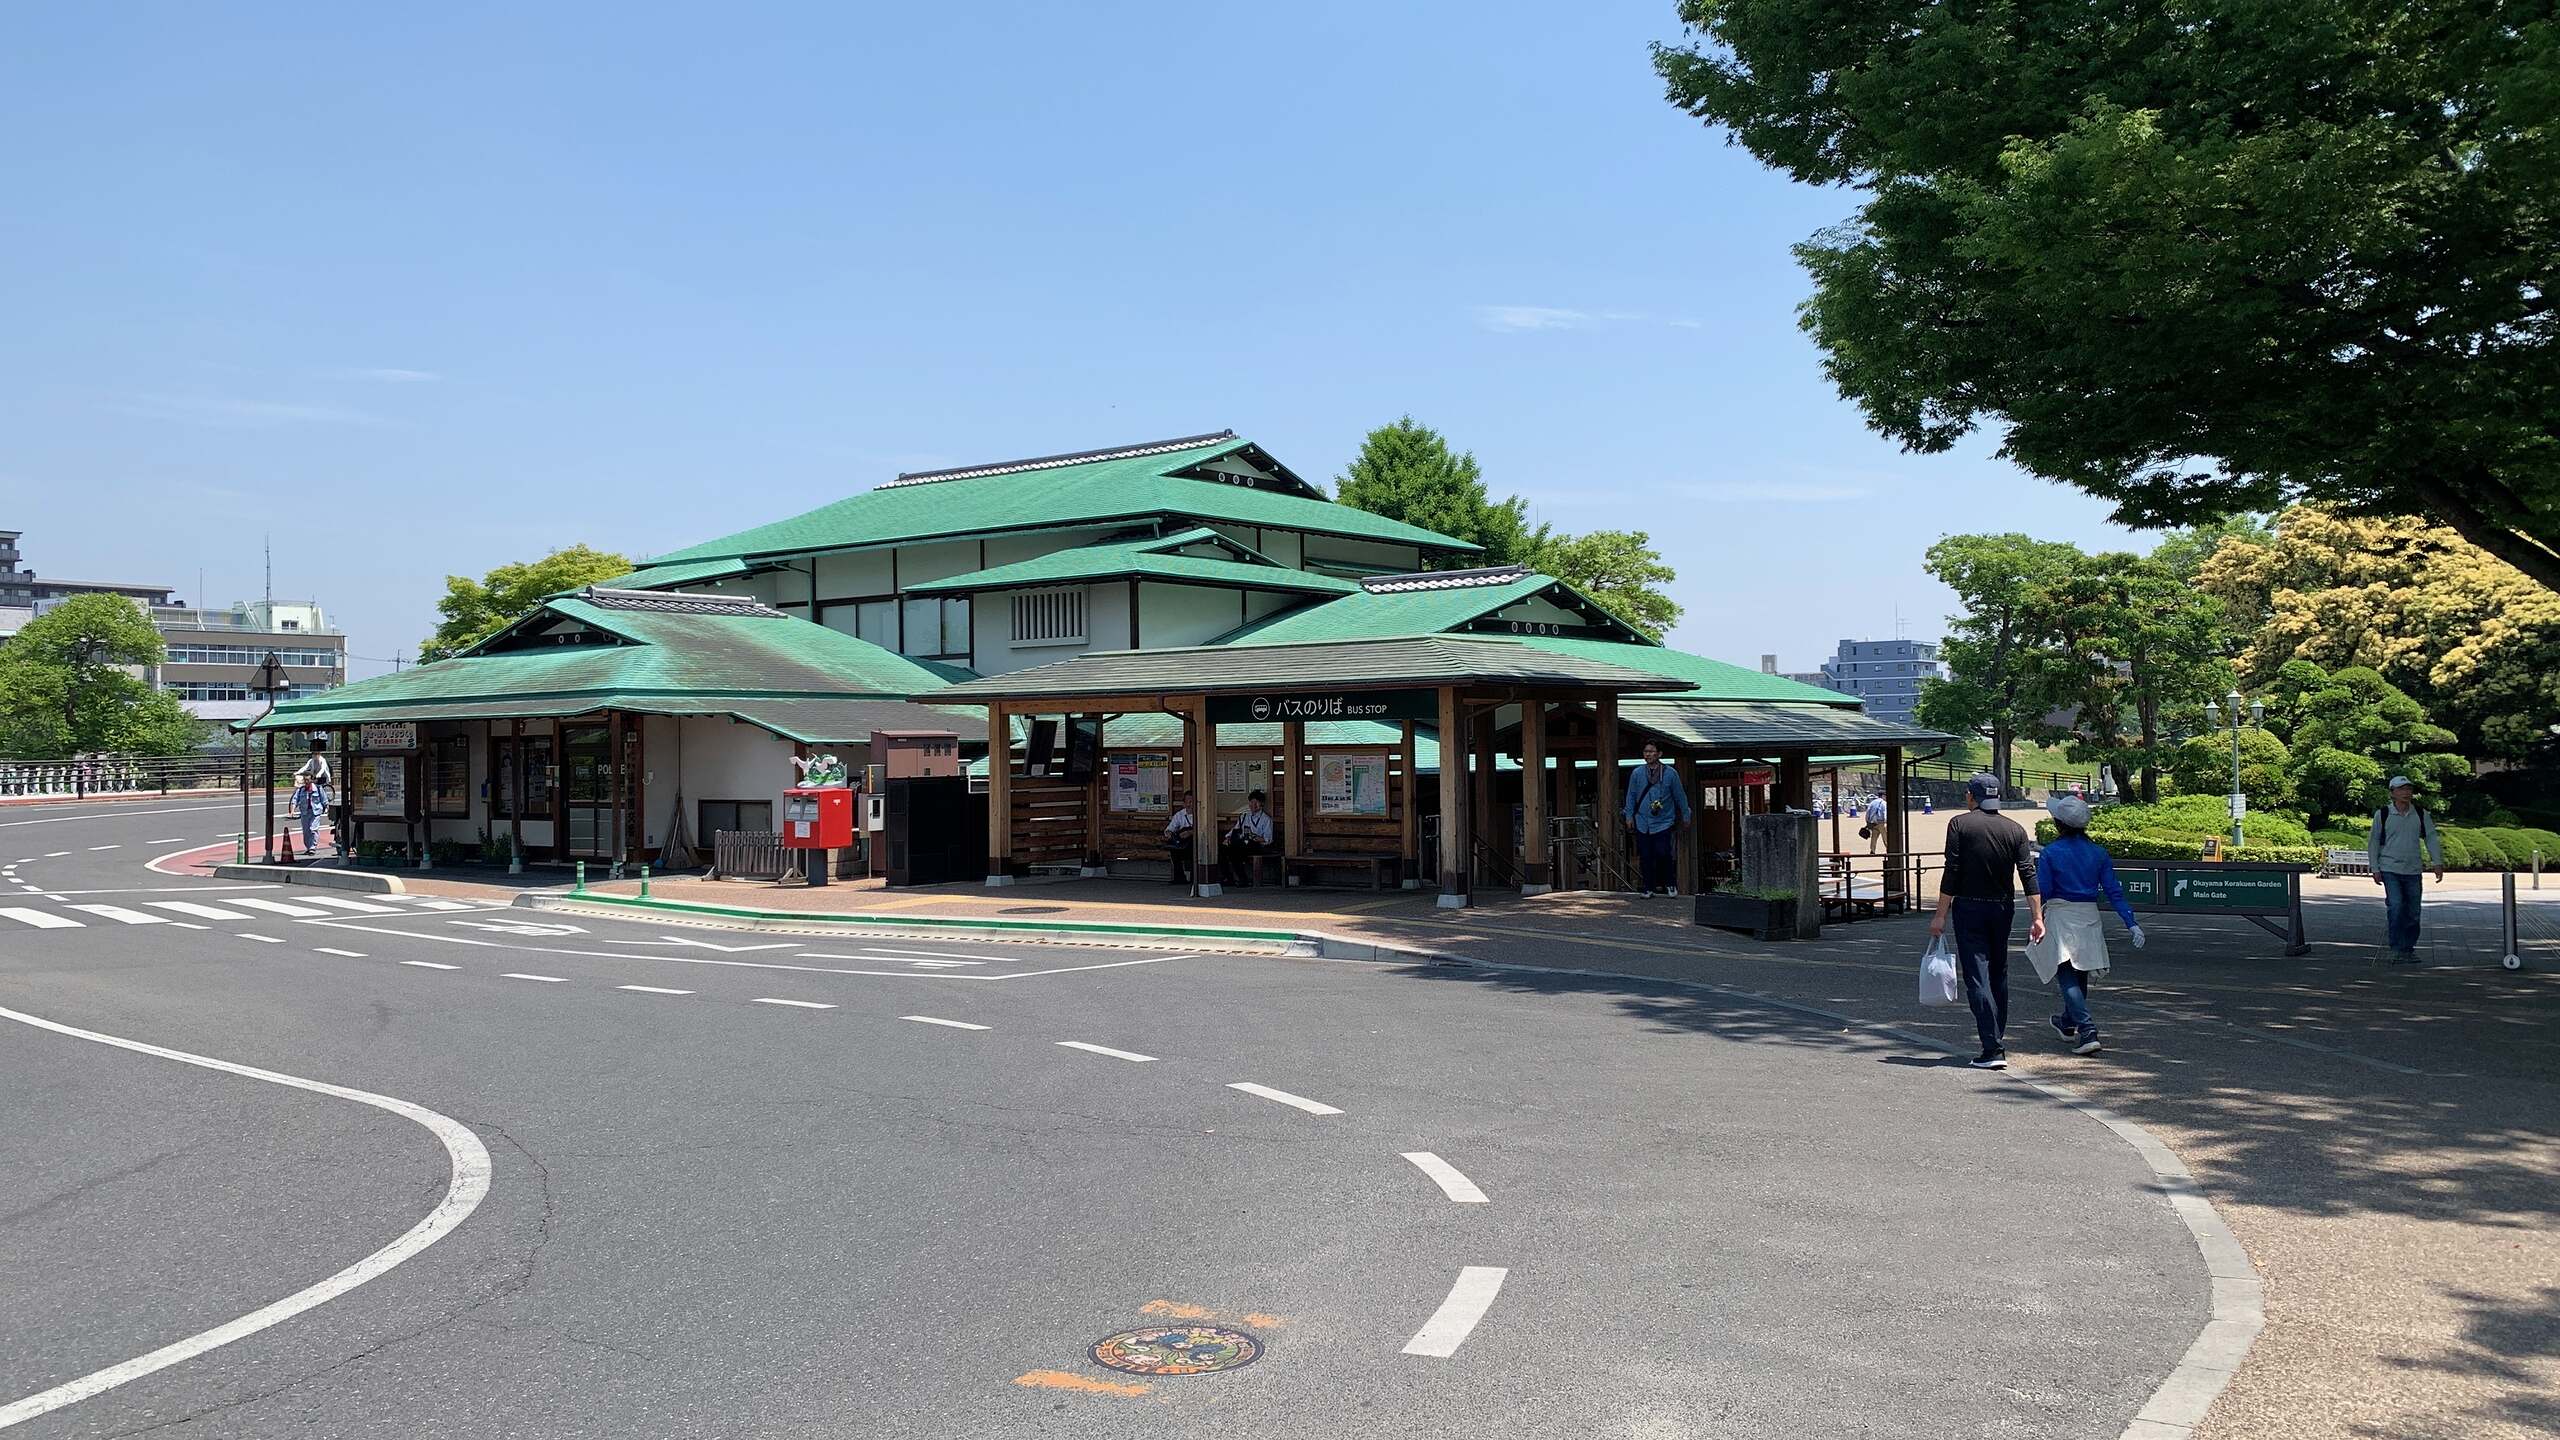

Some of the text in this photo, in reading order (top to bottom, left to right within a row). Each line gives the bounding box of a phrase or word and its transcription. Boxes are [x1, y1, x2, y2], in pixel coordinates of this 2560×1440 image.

[1276, 697, 1343, 715] バスのりば
[1347, 705, 1387, 714] BUS STOP
[597, 764, 625, 775] POLE
[2128, 881, 2151, 893] 正門
[2192, 880, 2223, 889] Okayama
[2224, 880, 2256, 888] Korakuen
[2193, 891, 2209, 899] Main
